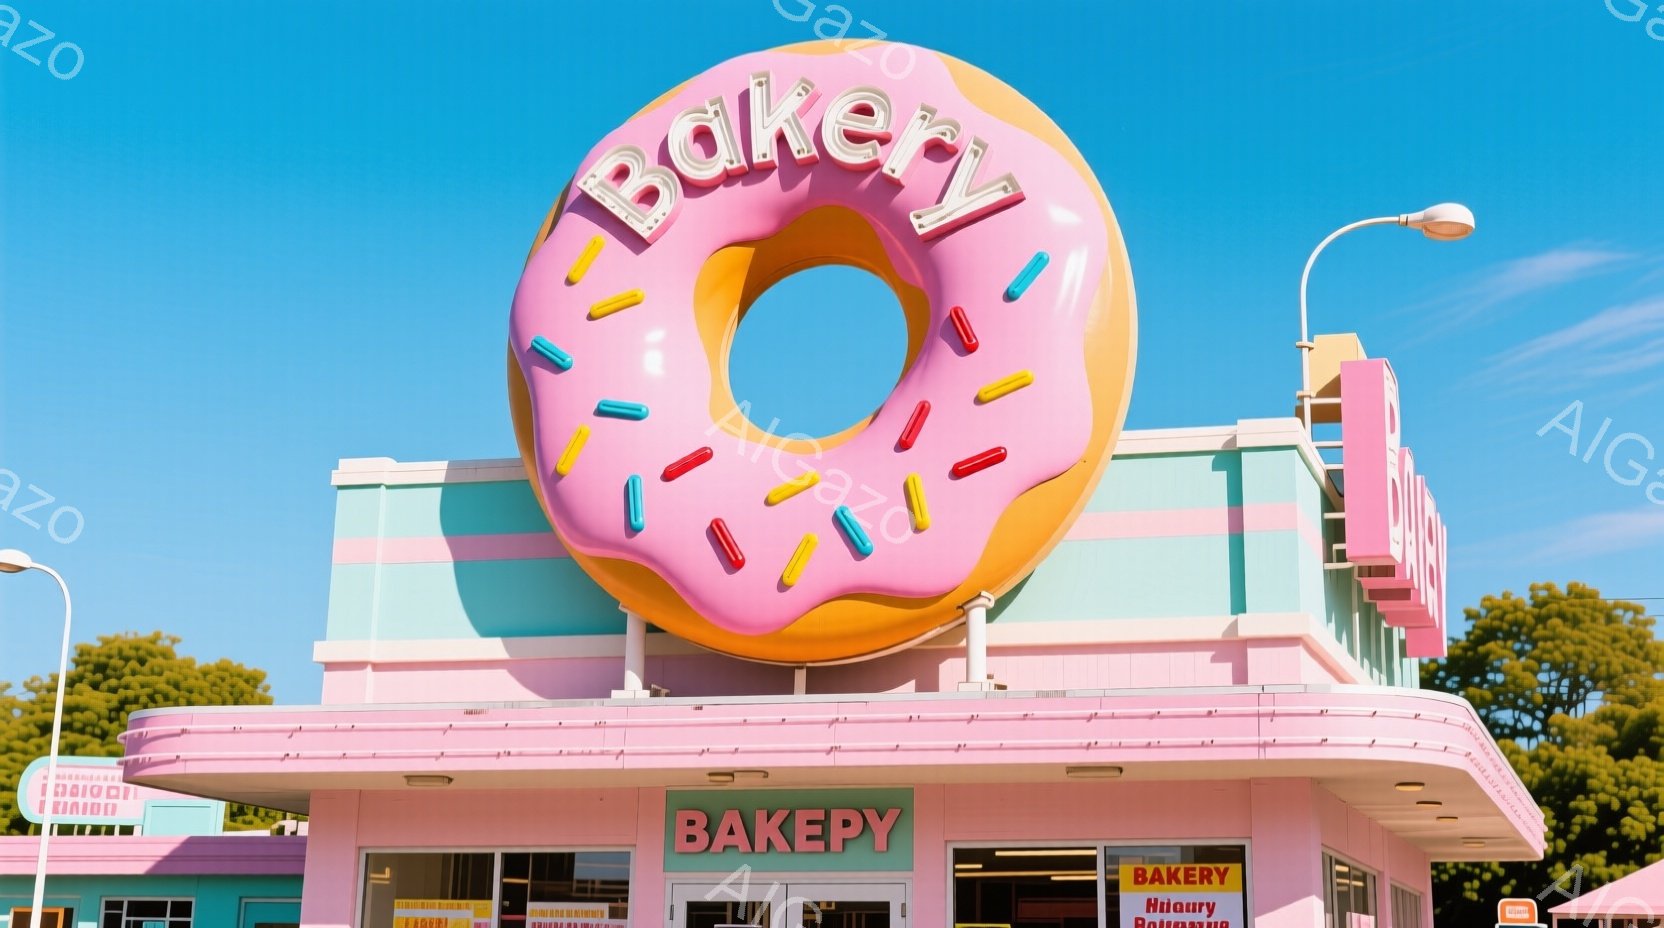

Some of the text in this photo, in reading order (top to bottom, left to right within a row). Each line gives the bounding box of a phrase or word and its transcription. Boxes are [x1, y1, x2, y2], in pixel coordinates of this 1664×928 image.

[576, 69, 1026, 246] Bakery
[673, 807, 903, 854] BAKEPY
[1132, 866, 1230, 886] BAKERY
